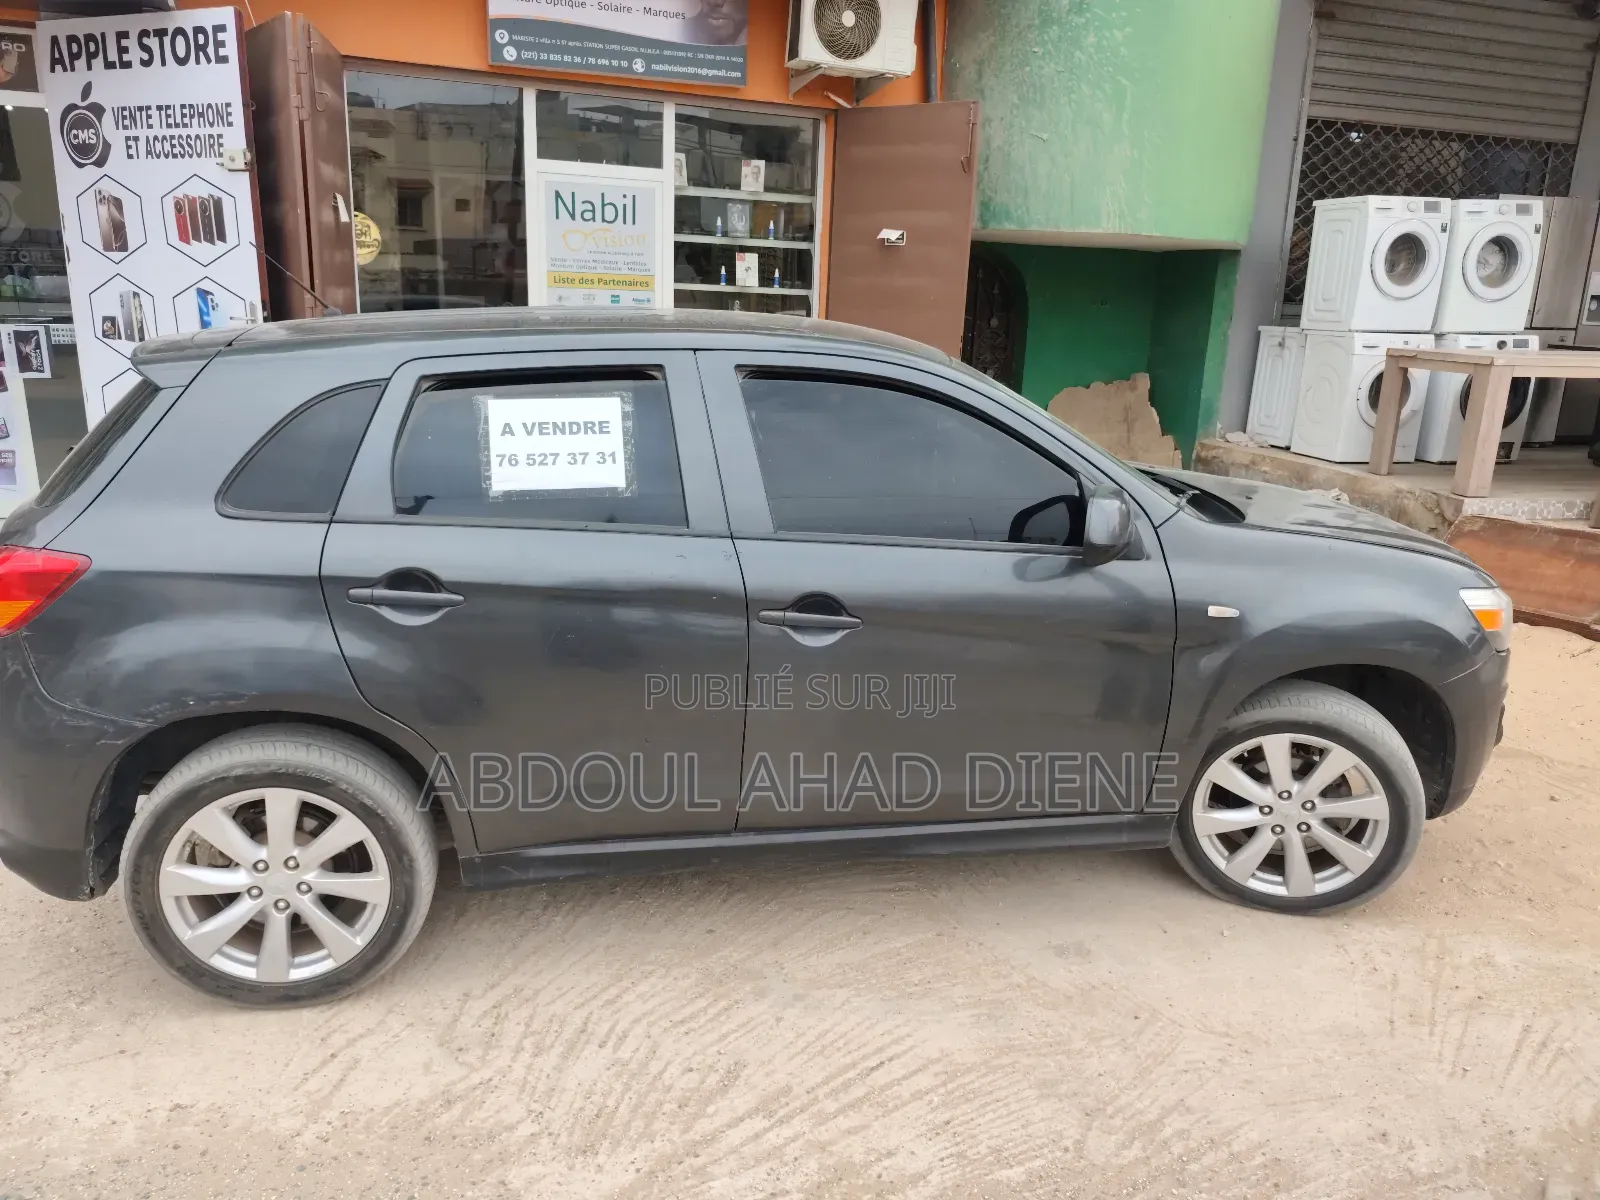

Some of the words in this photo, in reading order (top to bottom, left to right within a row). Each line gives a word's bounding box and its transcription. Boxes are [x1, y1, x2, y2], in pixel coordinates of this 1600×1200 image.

[597, 1, 632, 13] Solaire
[643, 7, 686, 19] Marques
[50, 31, 132, 73] APPLE
[137, 24, 229, 68] STORE
[521, 49, 538, 60] (221)
[539, 52, 548, 60] 33
[549, 53, 562, 61] 835
[587, 57, 596, 65] 78
[597, 58, 609, 66] 696
[651, 63, 742, 78] nabilvision2016@gmail.com
[111, 105, 154, 131] VENTE
[156, 102, 234, 131] TELEPHONE
[69, 128, 97, 145] CMS
[124, 135, 140, 160] ET
[145, 133, 224, 160] ACCESSOIRE
[554, 189, 636, 226] Nabil
[553, 275, 576, 284] Liste
[578, 276, 595, 285] des
[597, 277, 650, 288] Partenaires
[500, 422, 515, 436] A
[522, 421, 611, 436] VENDRE
[495, 453, 519, 467] 76
[526, 452, 560, 467] 527
[566, 452, 590, 466] 37
[596, 451, 617, 465] 31
